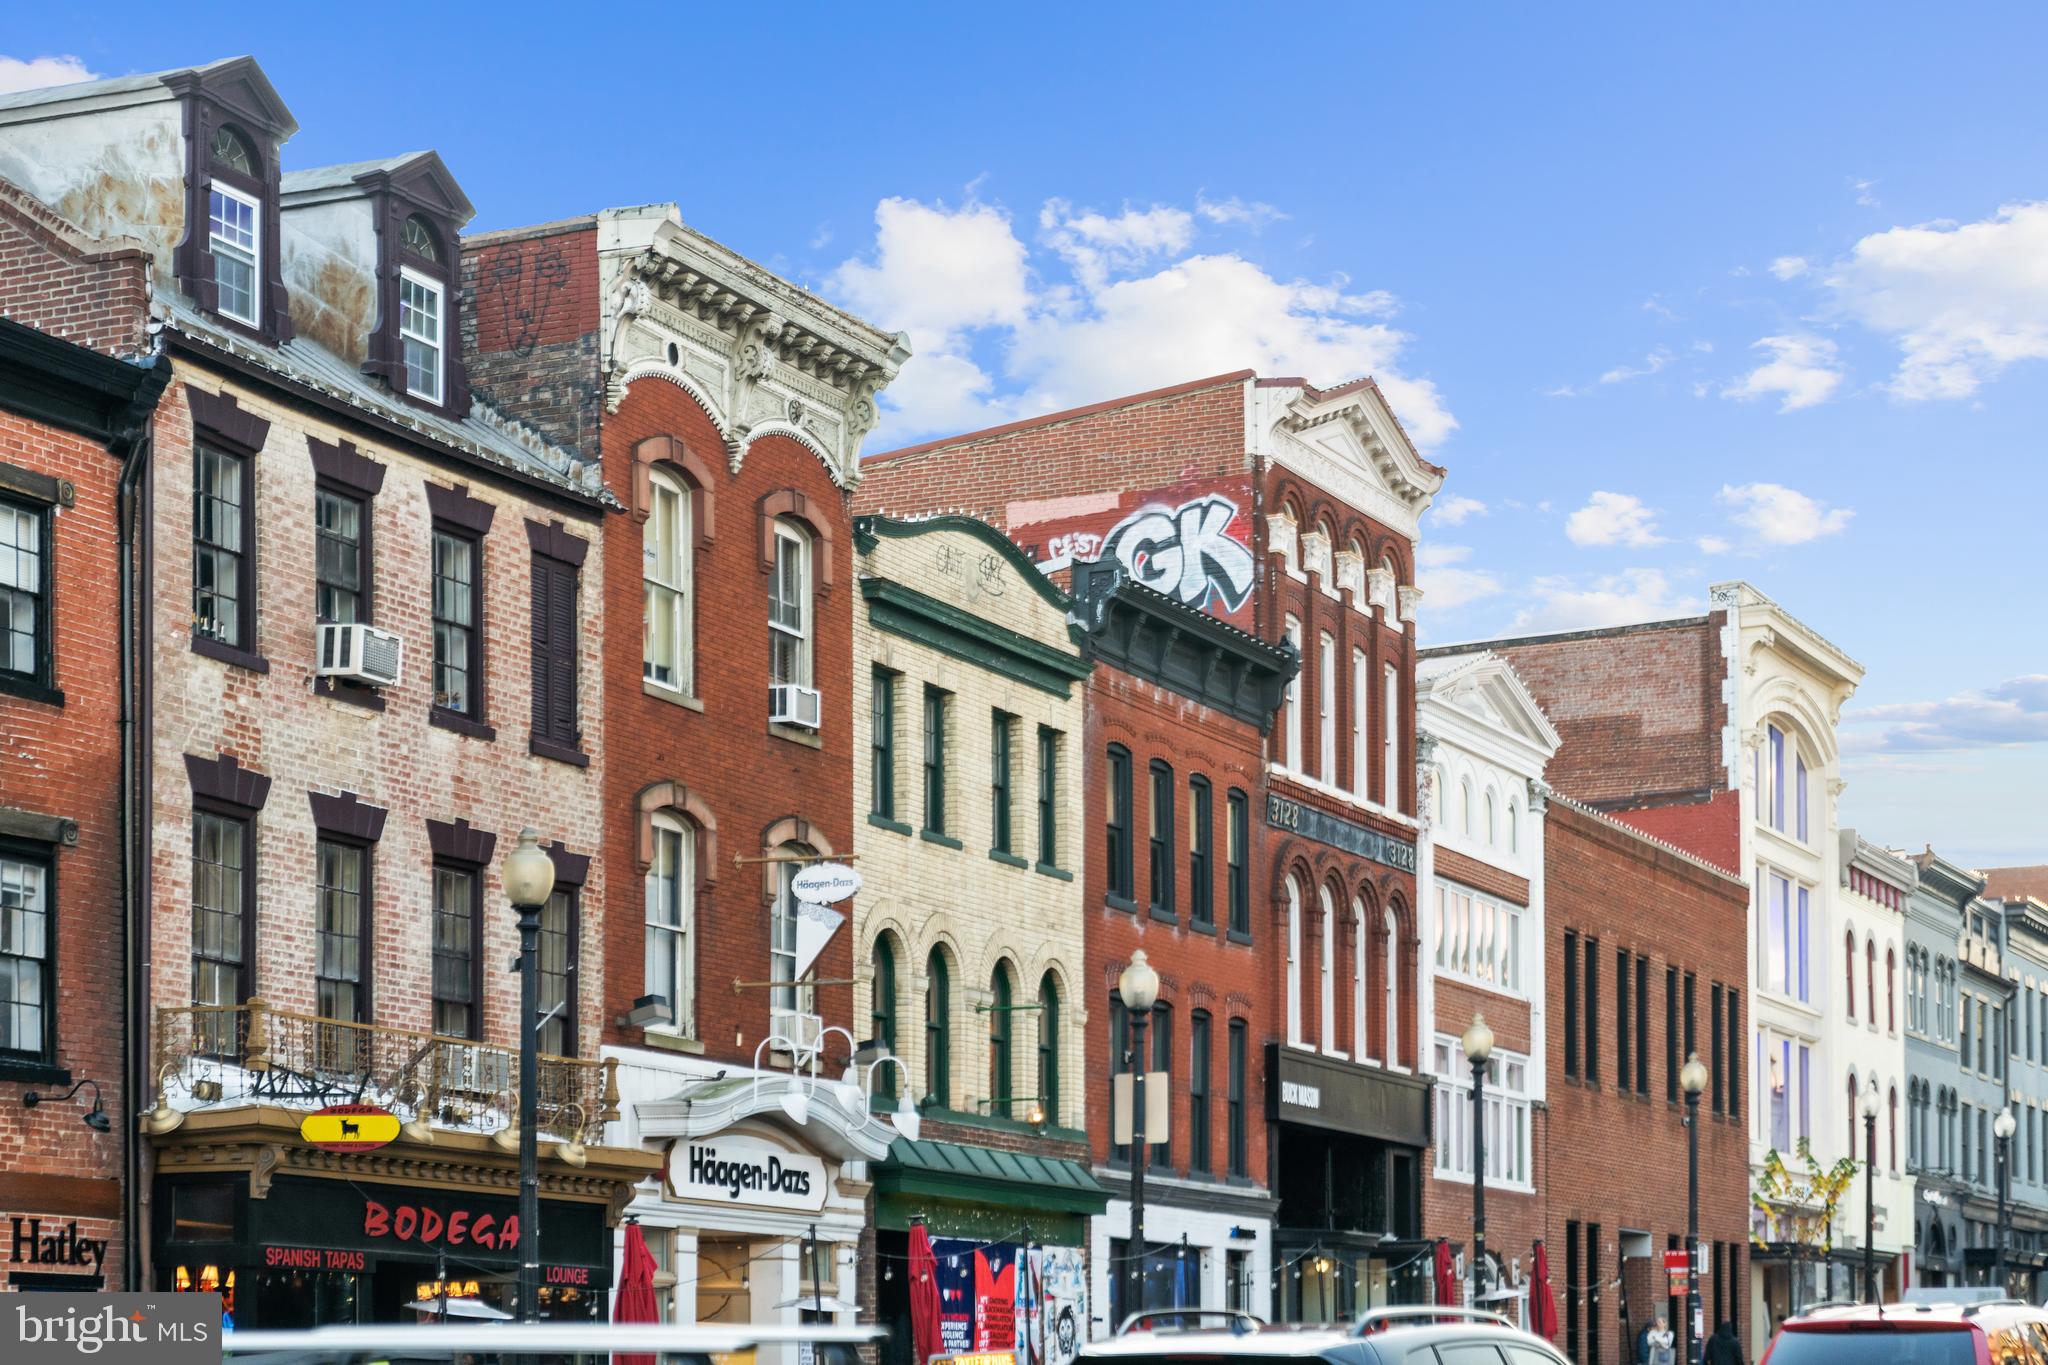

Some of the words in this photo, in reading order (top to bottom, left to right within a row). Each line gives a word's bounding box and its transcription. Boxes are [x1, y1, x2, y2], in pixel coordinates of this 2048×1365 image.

[1105, 494, 1255, 612] GK
[1271, 799, 1298, 829] 3128
[1389, 842, 1414, 869] 3128
[796, 878, 854, 891] Häagen-Dazs
[689, 1145, 810, 1198] Häagen-Dazs
[364, 1201, 521, 1250] BODEGA
[9, 1217, 109, 1277] Hatley
[266, 1247, 321, 1268] SPANISH
[325, 1250, 365, 1270] TAPAS
[546, 1266, 589, 1285] LOUNGE
[941, 1321, 967, 1331] XPERIENCE
